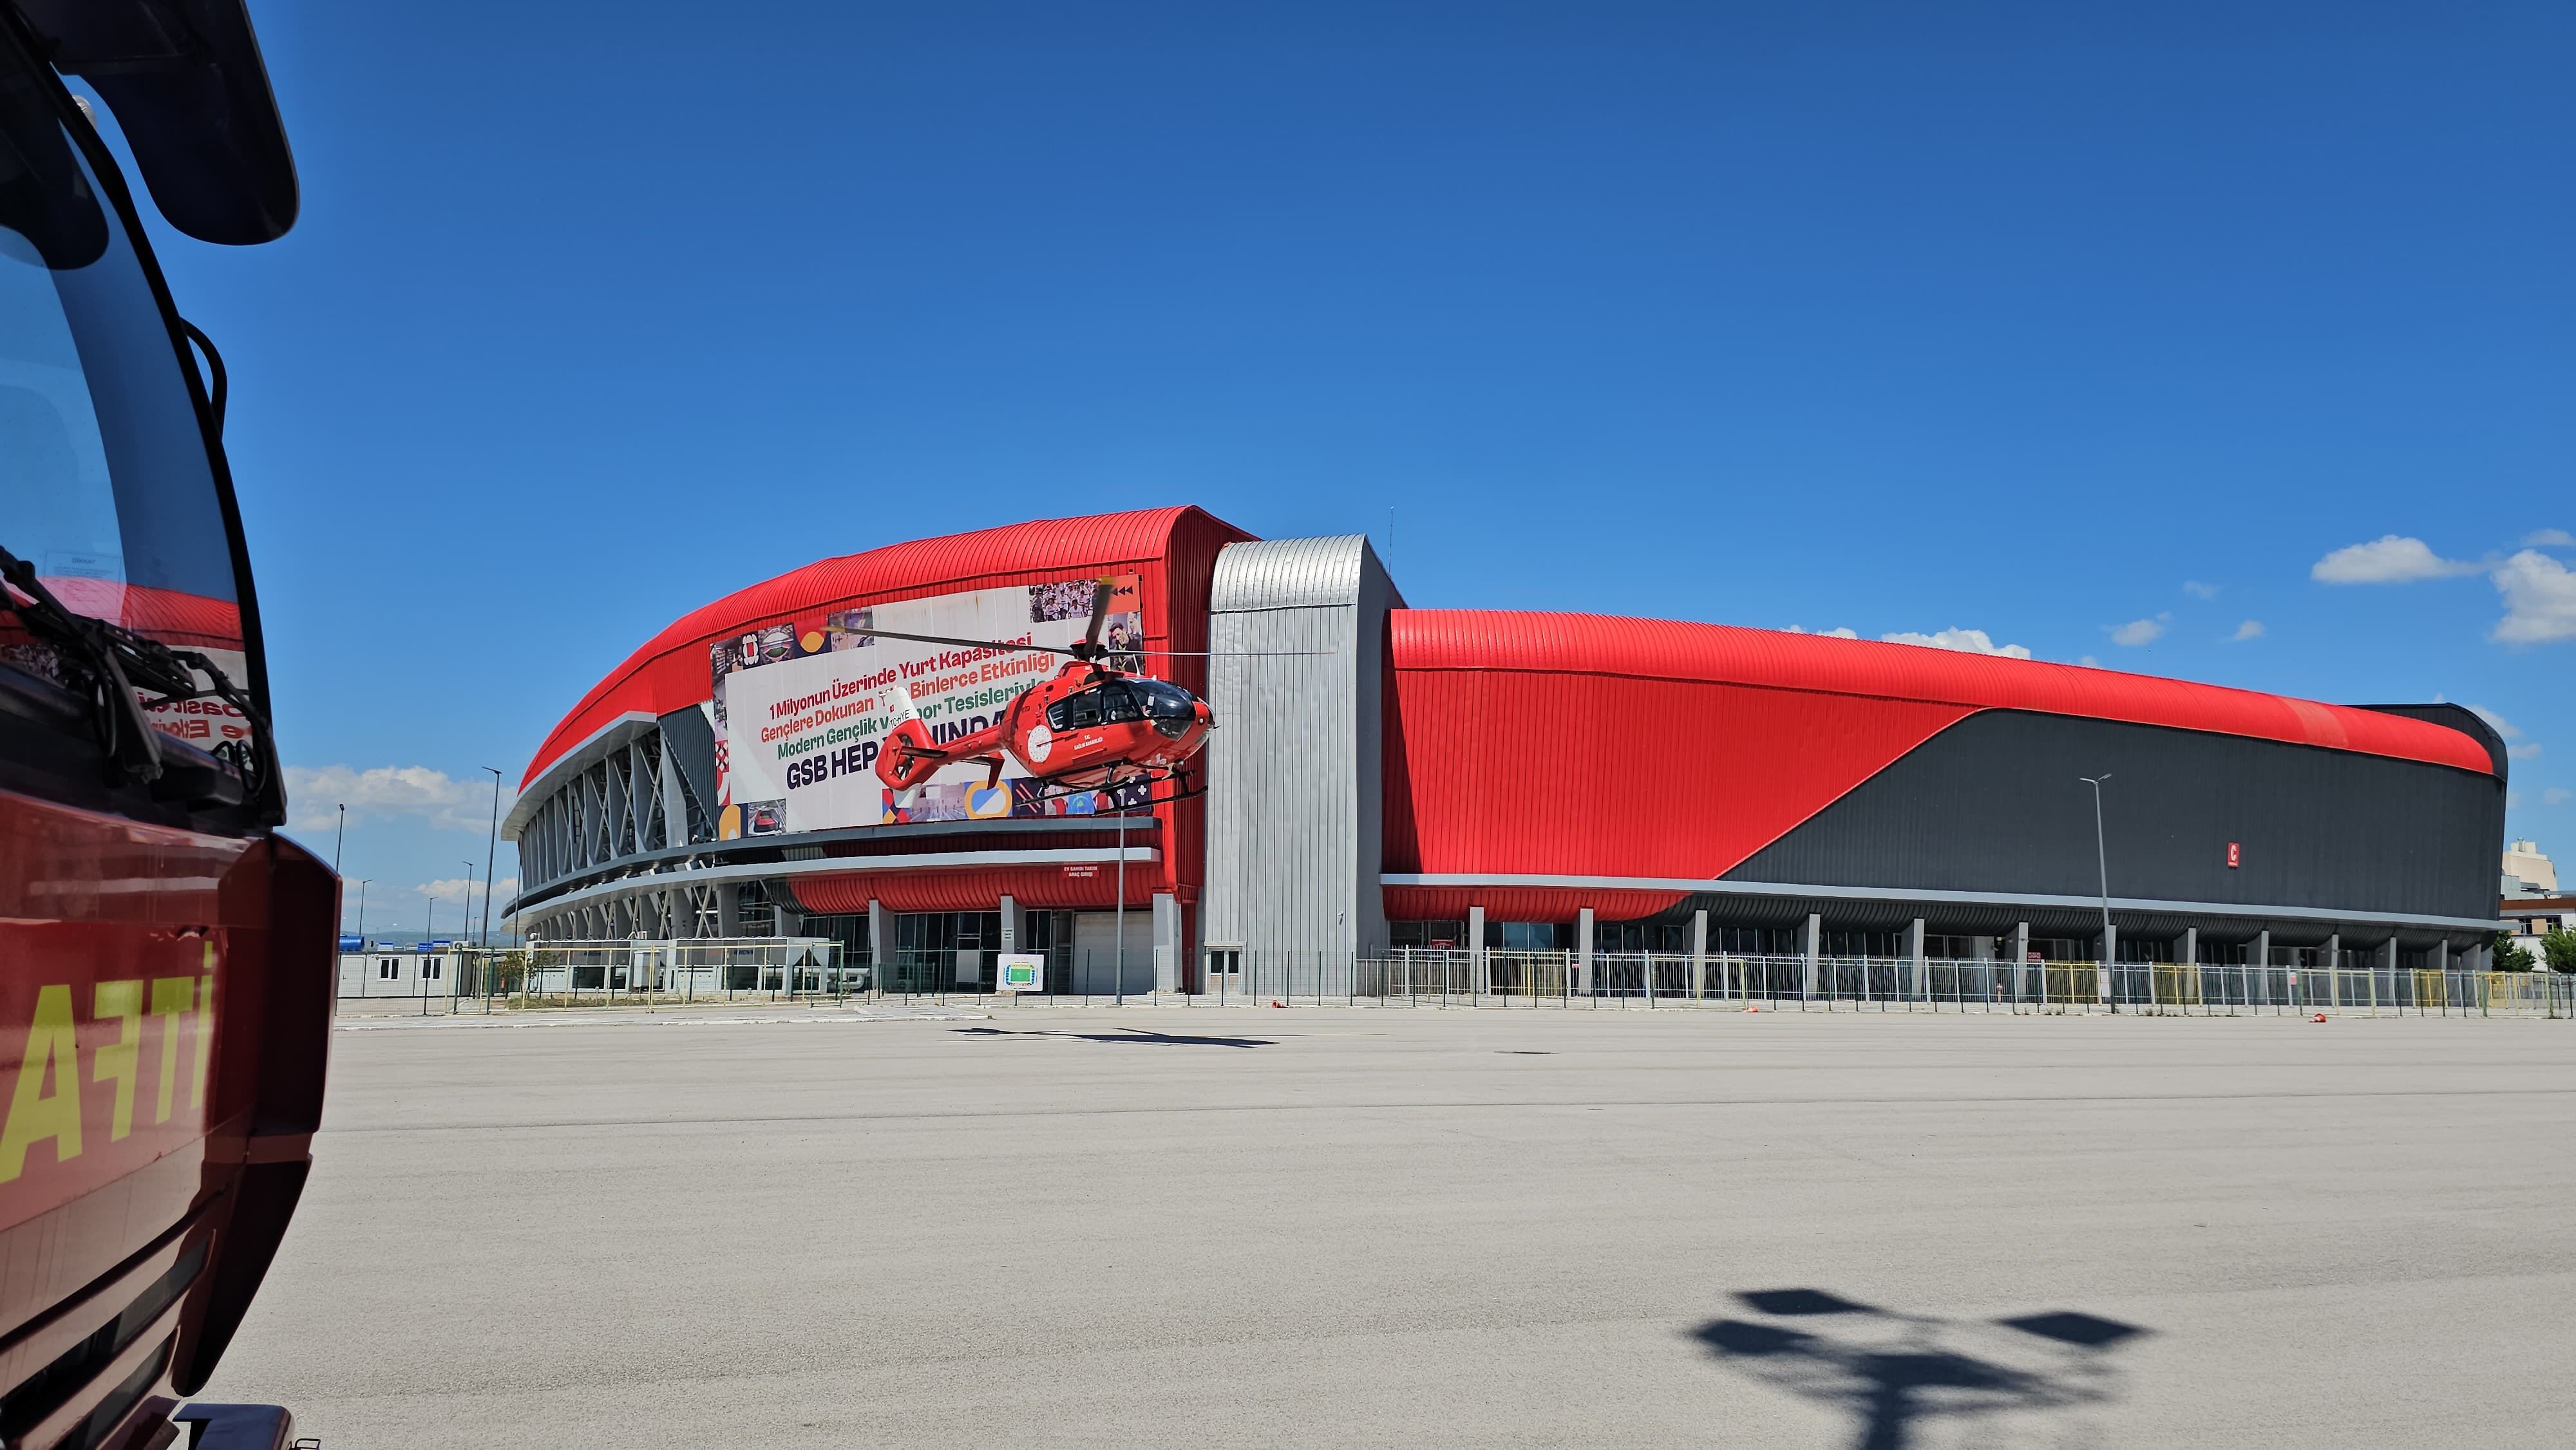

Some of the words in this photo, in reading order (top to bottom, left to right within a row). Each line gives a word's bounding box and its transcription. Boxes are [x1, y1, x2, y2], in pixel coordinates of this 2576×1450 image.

[761, 719, 814, 743] Gençlere
[815, 697, 874, 726] Dokunan
[910, 671, 978, 700] Binlerce
[770, 704, 775, 720] 1
[777, 689, 830, 717] Milyonun
[832, 668, 896, 700] Üzerinde
[899, 655, 937, 678] Yurt
[777, 734, 824, 760] Modern
[826, 718, 878, 745] Gençlik
[786, 754, 828, 790] GSB
[831, 740, 879, 778] HEP
[2230, 844, 2237, 862] C
